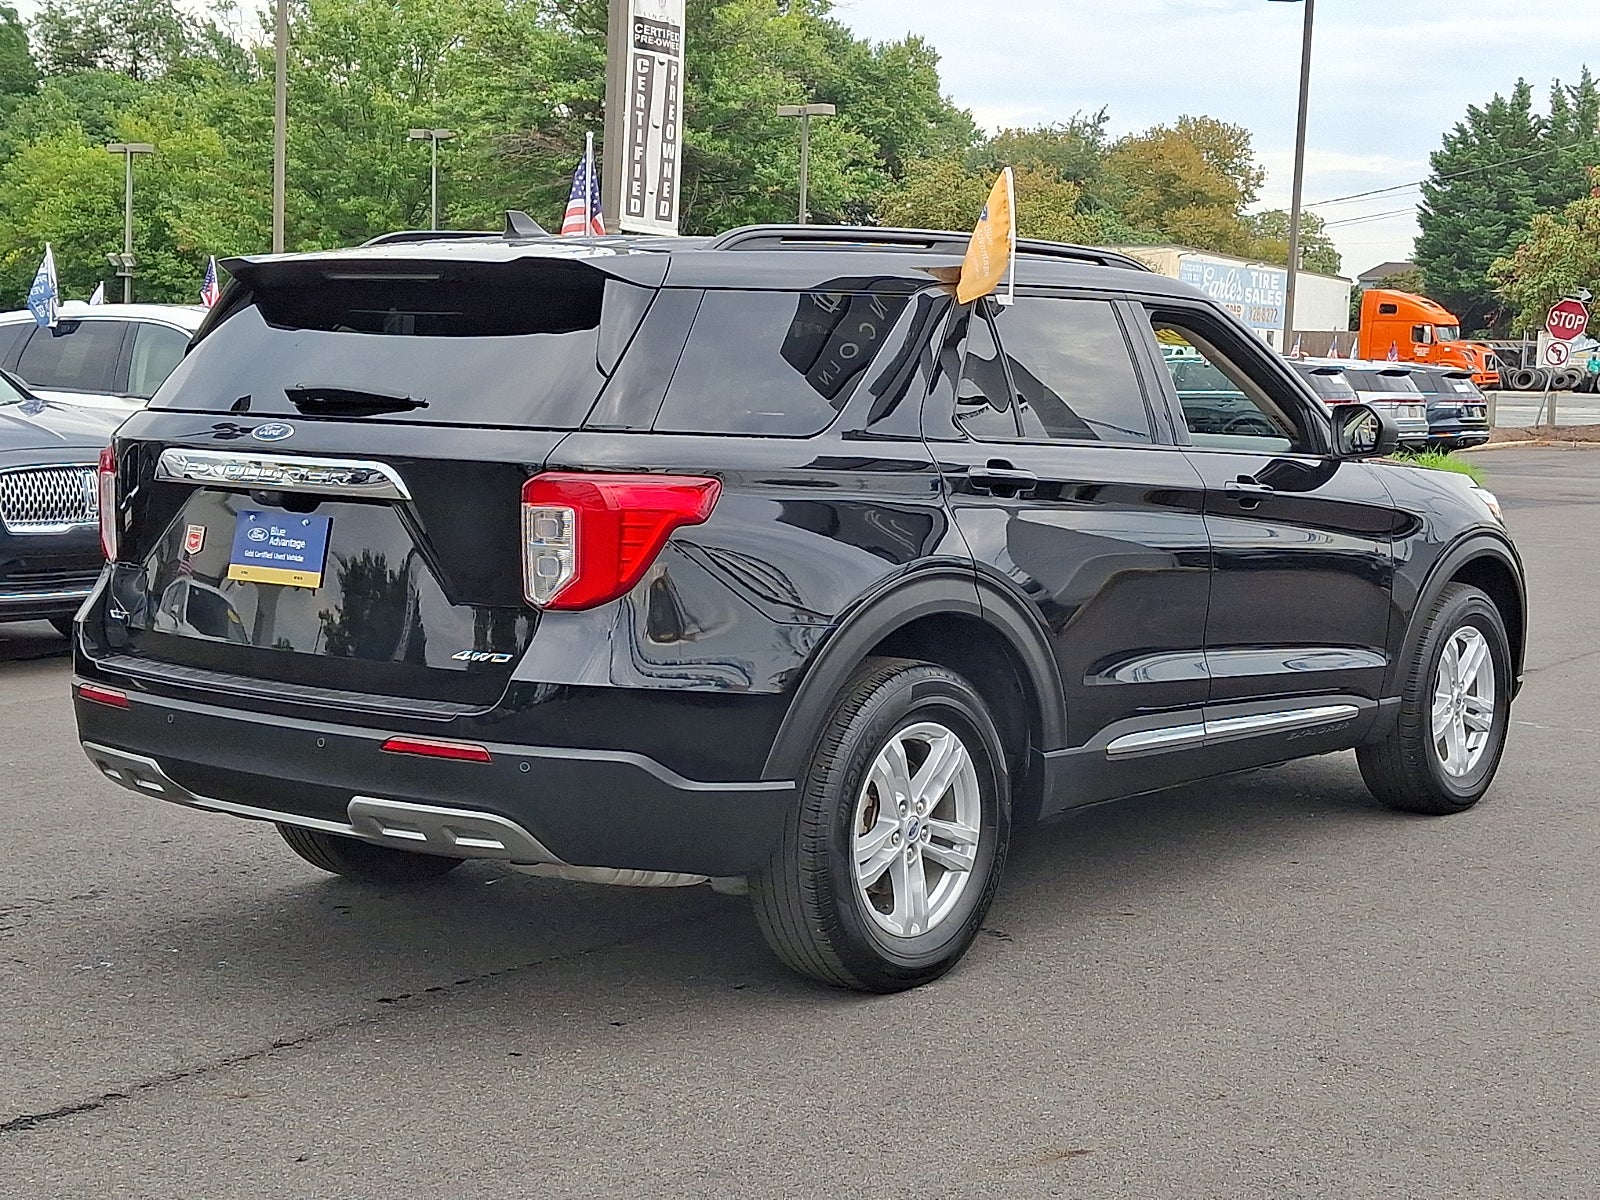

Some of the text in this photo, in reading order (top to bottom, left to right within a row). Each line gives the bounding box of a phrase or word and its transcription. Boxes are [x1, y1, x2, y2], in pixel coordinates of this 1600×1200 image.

[634, 23, 681, 42] CERTIFED
[634, 34, 680, 50] PRE-OWED
[630, 58, 650, 213] CERTIFIED
[659, 65, 678, 217] PREOWNED
[1201, 267, 1245, 301] Earle's
[1251, 271, 1280, 290] TIRE
[1244, 287, 1282, 307] SALES
[1549, 310, 1585, 330] STOP
[183, 461, 353, 487] EXPLORER
[270, 526, 287, 537] Blue
[268, 536, 306, 550] Advantage
[254, 550, 274, 560] Certified
[273, 552, 286, 561] Used
[286, 553, 305, 563] Vehicle
[450, 650, 514, 663] 4WD
